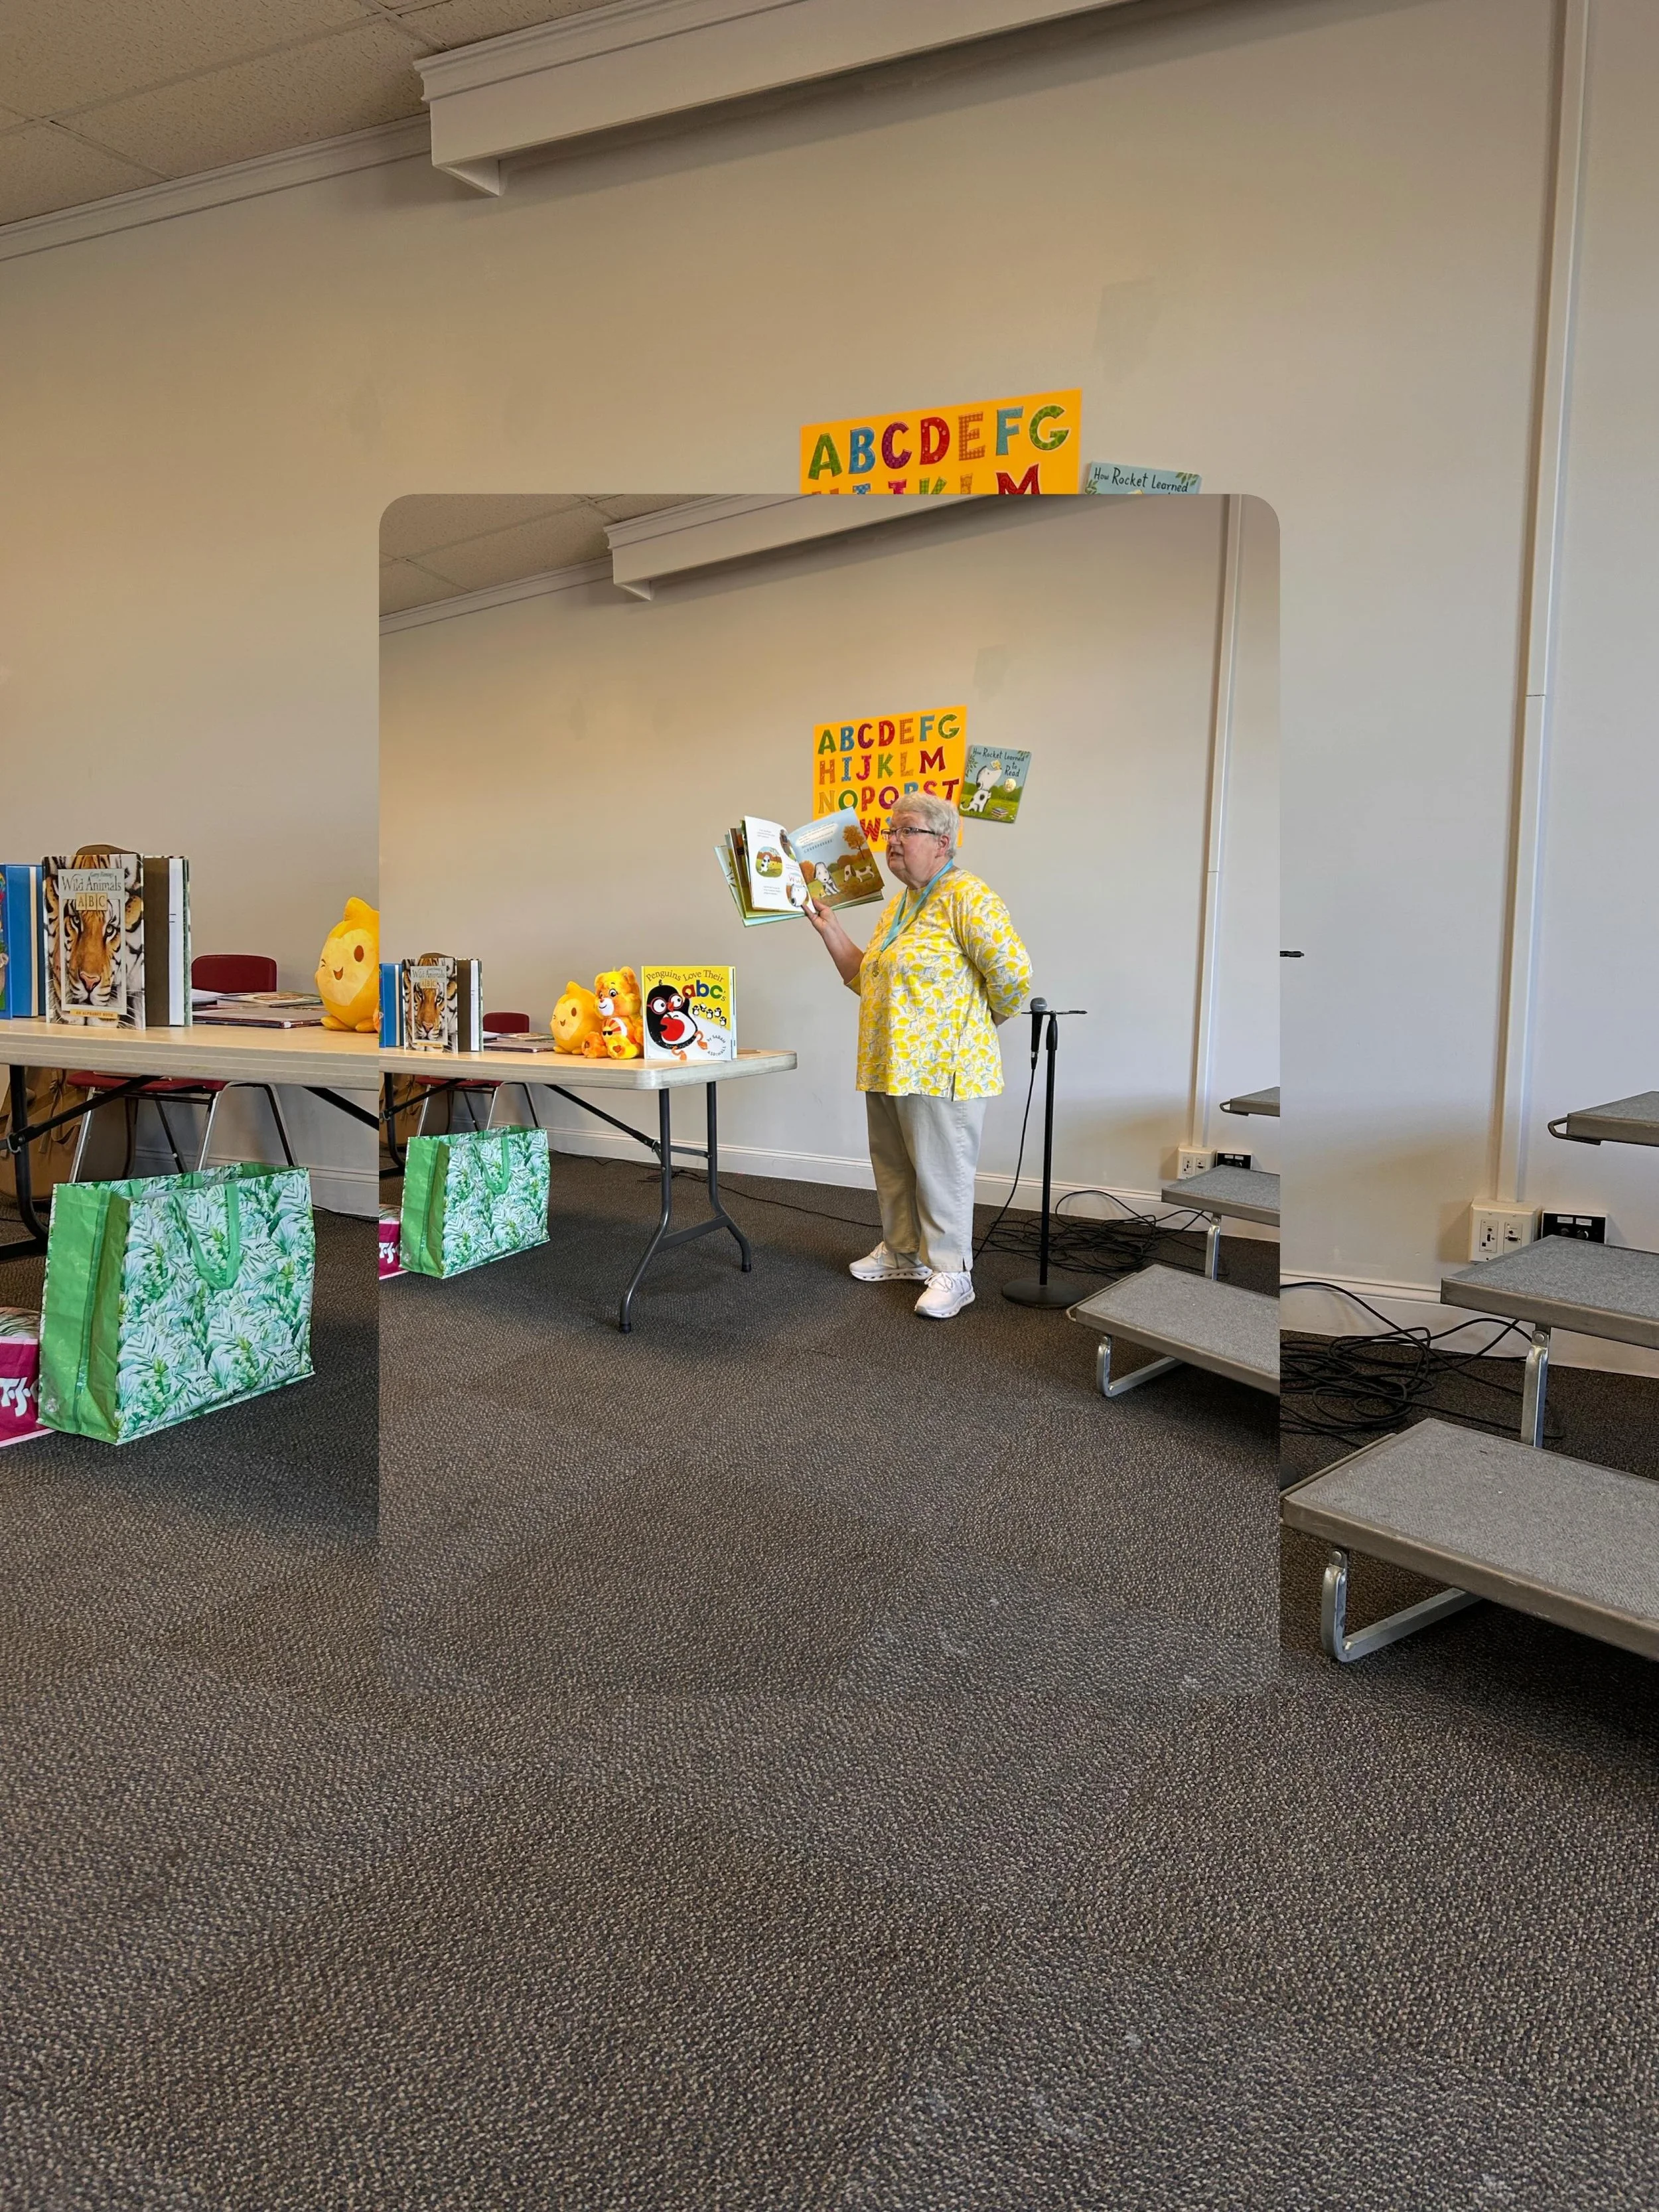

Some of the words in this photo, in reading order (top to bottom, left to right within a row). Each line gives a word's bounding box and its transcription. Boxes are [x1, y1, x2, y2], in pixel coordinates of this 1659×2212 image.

[808, 404, 1070, 480] ABCDEFG
[1094, 467, 1109, 480] How
[1112, 467, 1148, 488] Rocket
[1151, 475, 1189, 492] Learned
[818, 713, 960, 755] ABCDEFG
[982, 747, 1002, 759] Rocket
[1004, 752, 1025, 761] Learned
[1005, 765, 1020, 777] Read
[61, 873, 84, 891] Wild
[86, 875, 122, 891] Animals
[646, 970, 681, 982] Penguins
[683, 971, 701, 982] Love
[703, 970, 725, 982] Their
